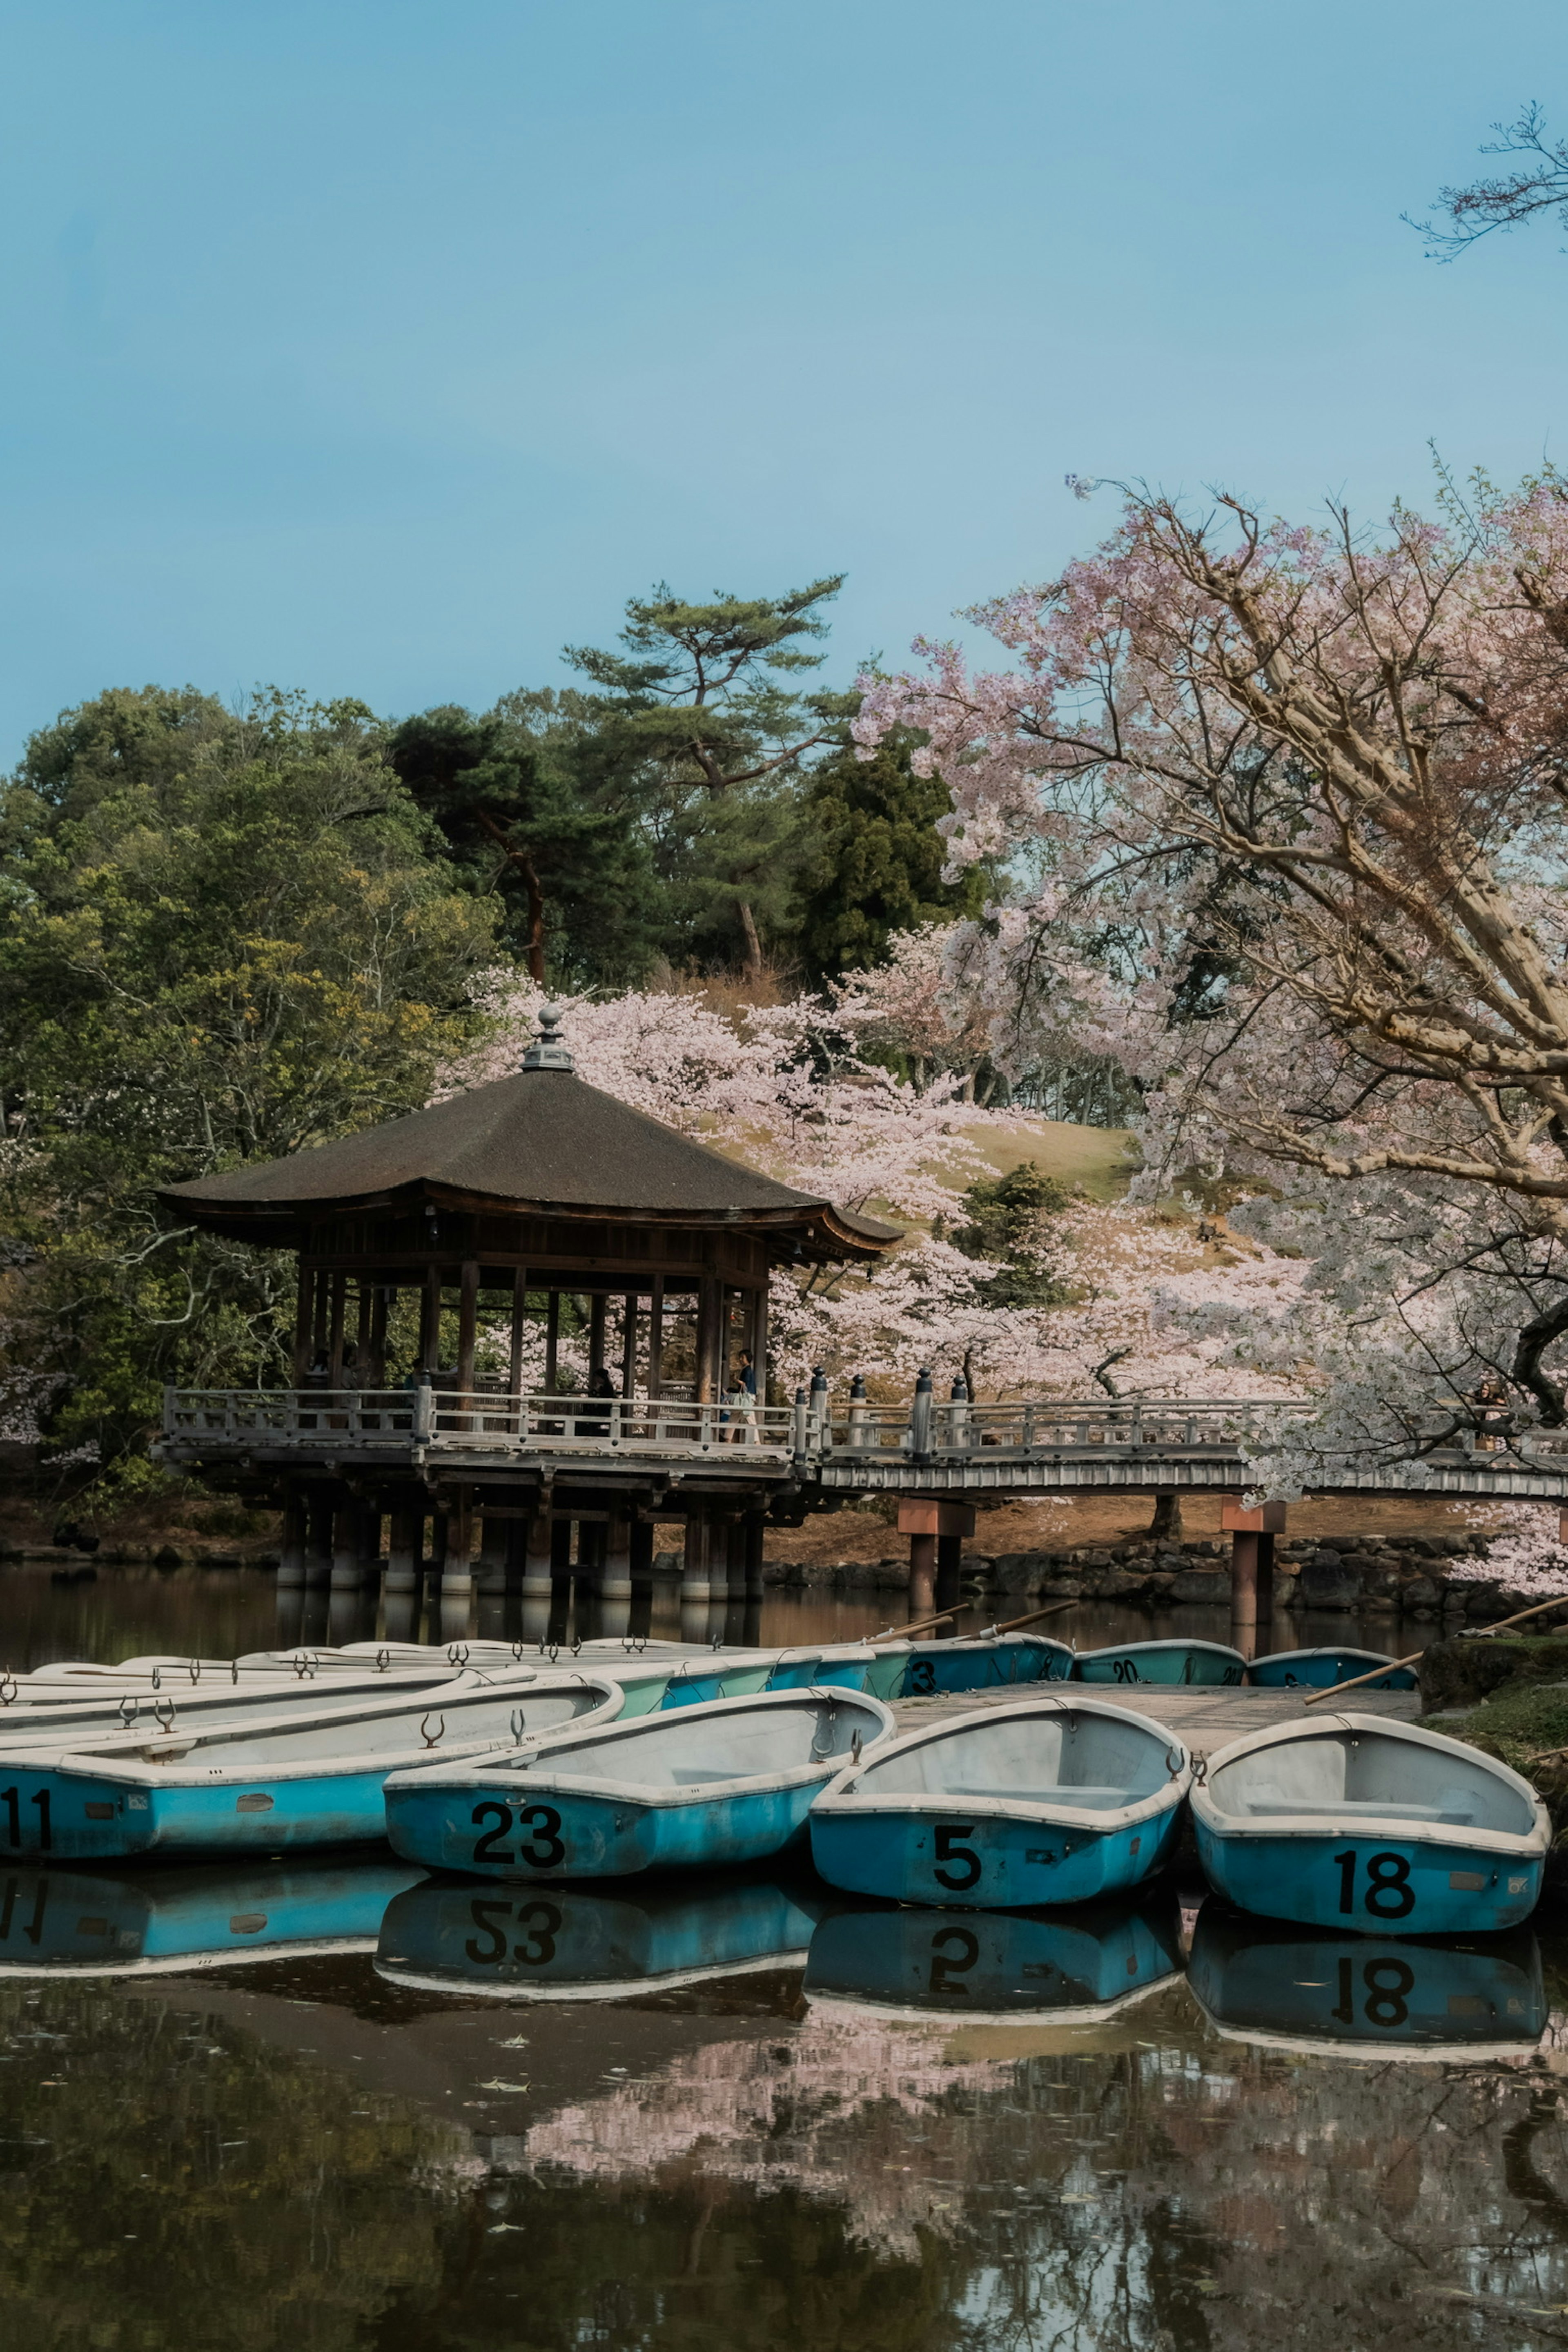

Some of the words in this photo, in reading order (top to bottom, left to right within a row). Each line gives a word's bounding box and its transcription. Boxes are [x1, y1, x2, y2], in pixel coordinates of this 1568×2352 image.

[912, 1661, 936, 1693] 3
[1, 1787, 51, 1850] 11
[472, 1802, 565, 1868] 23
[933, 1825, 982, 1891] 5
[1334, 1850, 1416, 1919] 18
